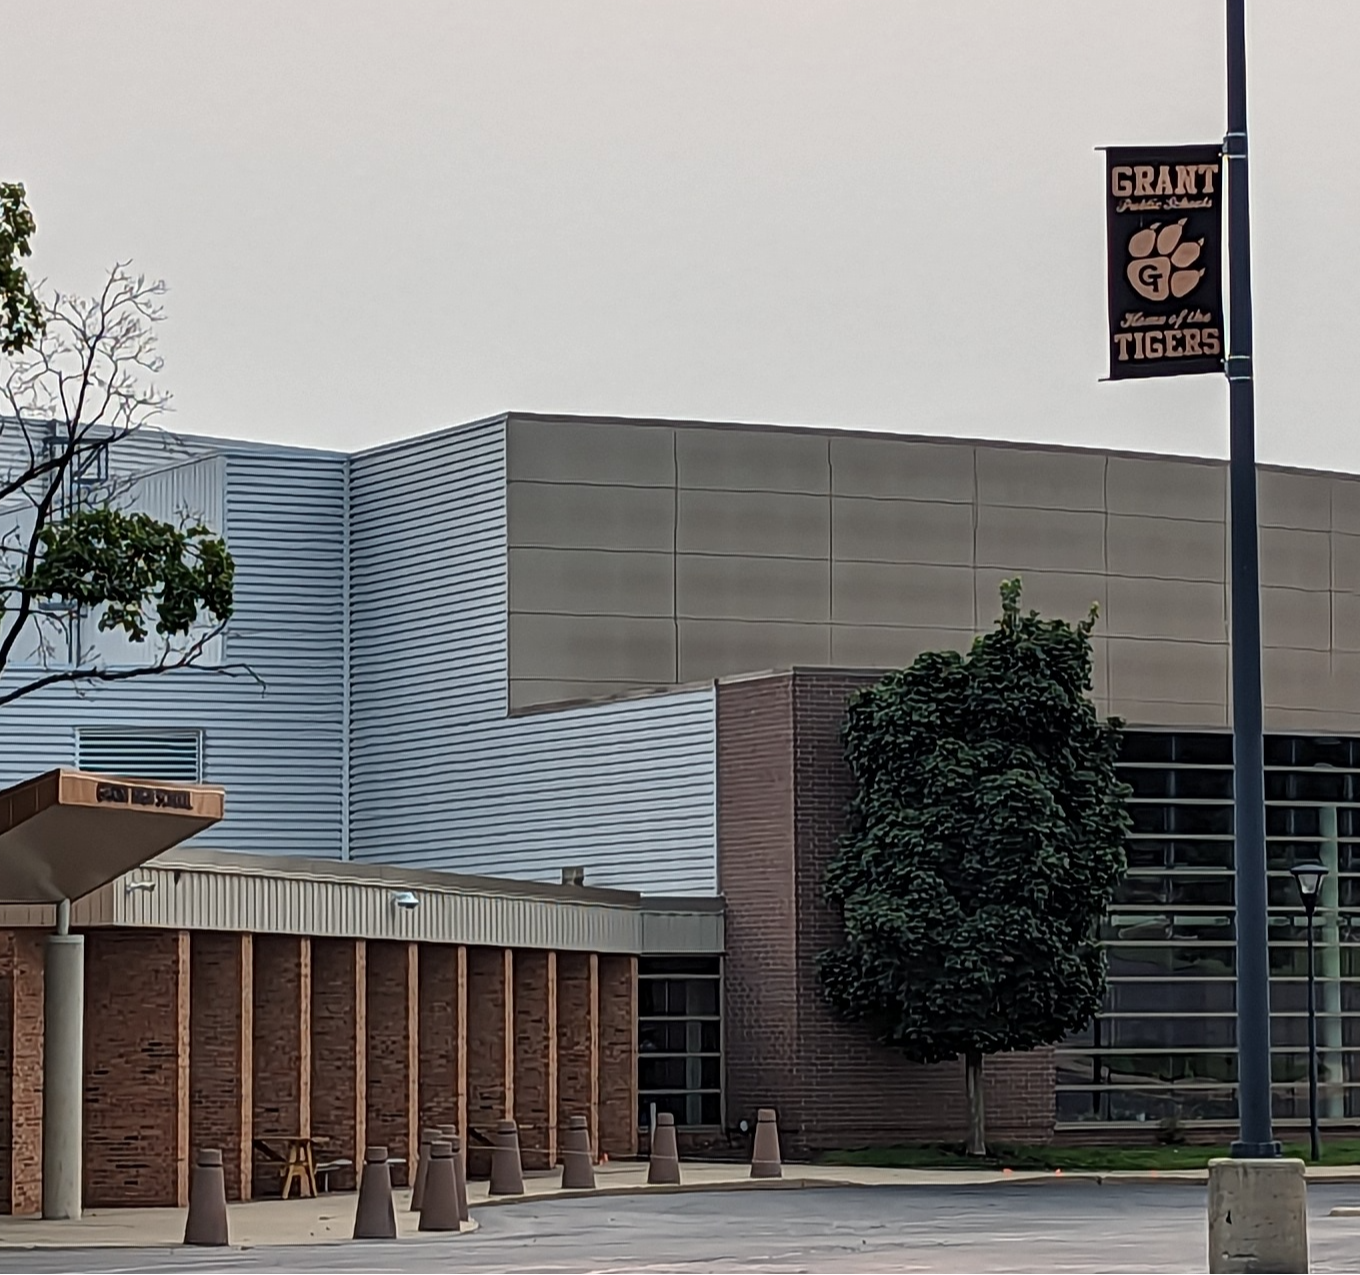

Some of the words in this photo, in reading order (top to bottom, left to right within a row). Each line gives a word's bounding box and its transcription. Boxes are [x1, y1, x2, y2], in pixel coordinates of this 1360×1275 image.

[1111, 164, 1219, 197] GRANT
[1120, 311, 1167, 328] Home
[1168, 308, 1189, 329] of
[1186, 308, 1212, 323] the
[1114, 328, 1220, 361] TIGERS
